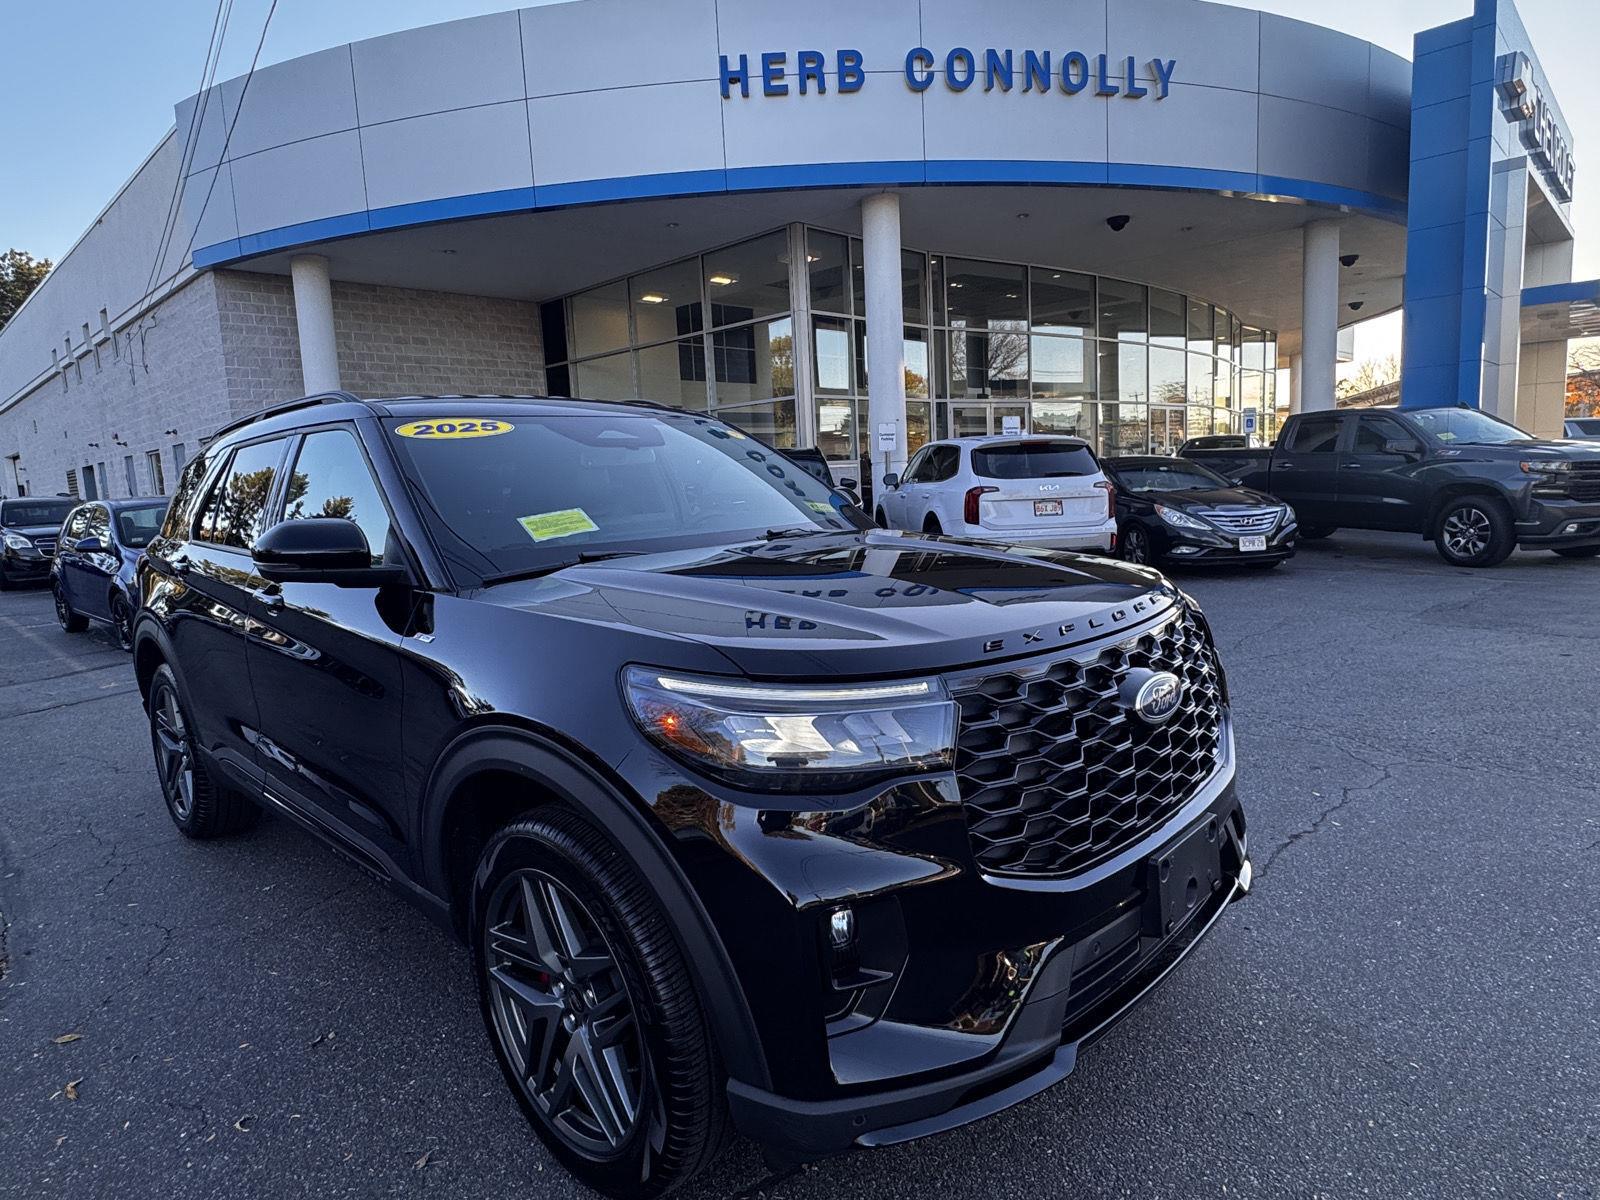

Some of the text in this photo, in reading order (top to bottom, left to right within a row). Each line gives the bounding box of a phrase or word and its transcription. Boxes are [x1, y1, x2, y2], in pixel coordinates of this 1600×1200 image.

[719, 47, 1176, 100] HERB CONNOLLY
[1534, 85, 1576, 201] CHEVROLE
[413, 422, 500, 435] 2025
